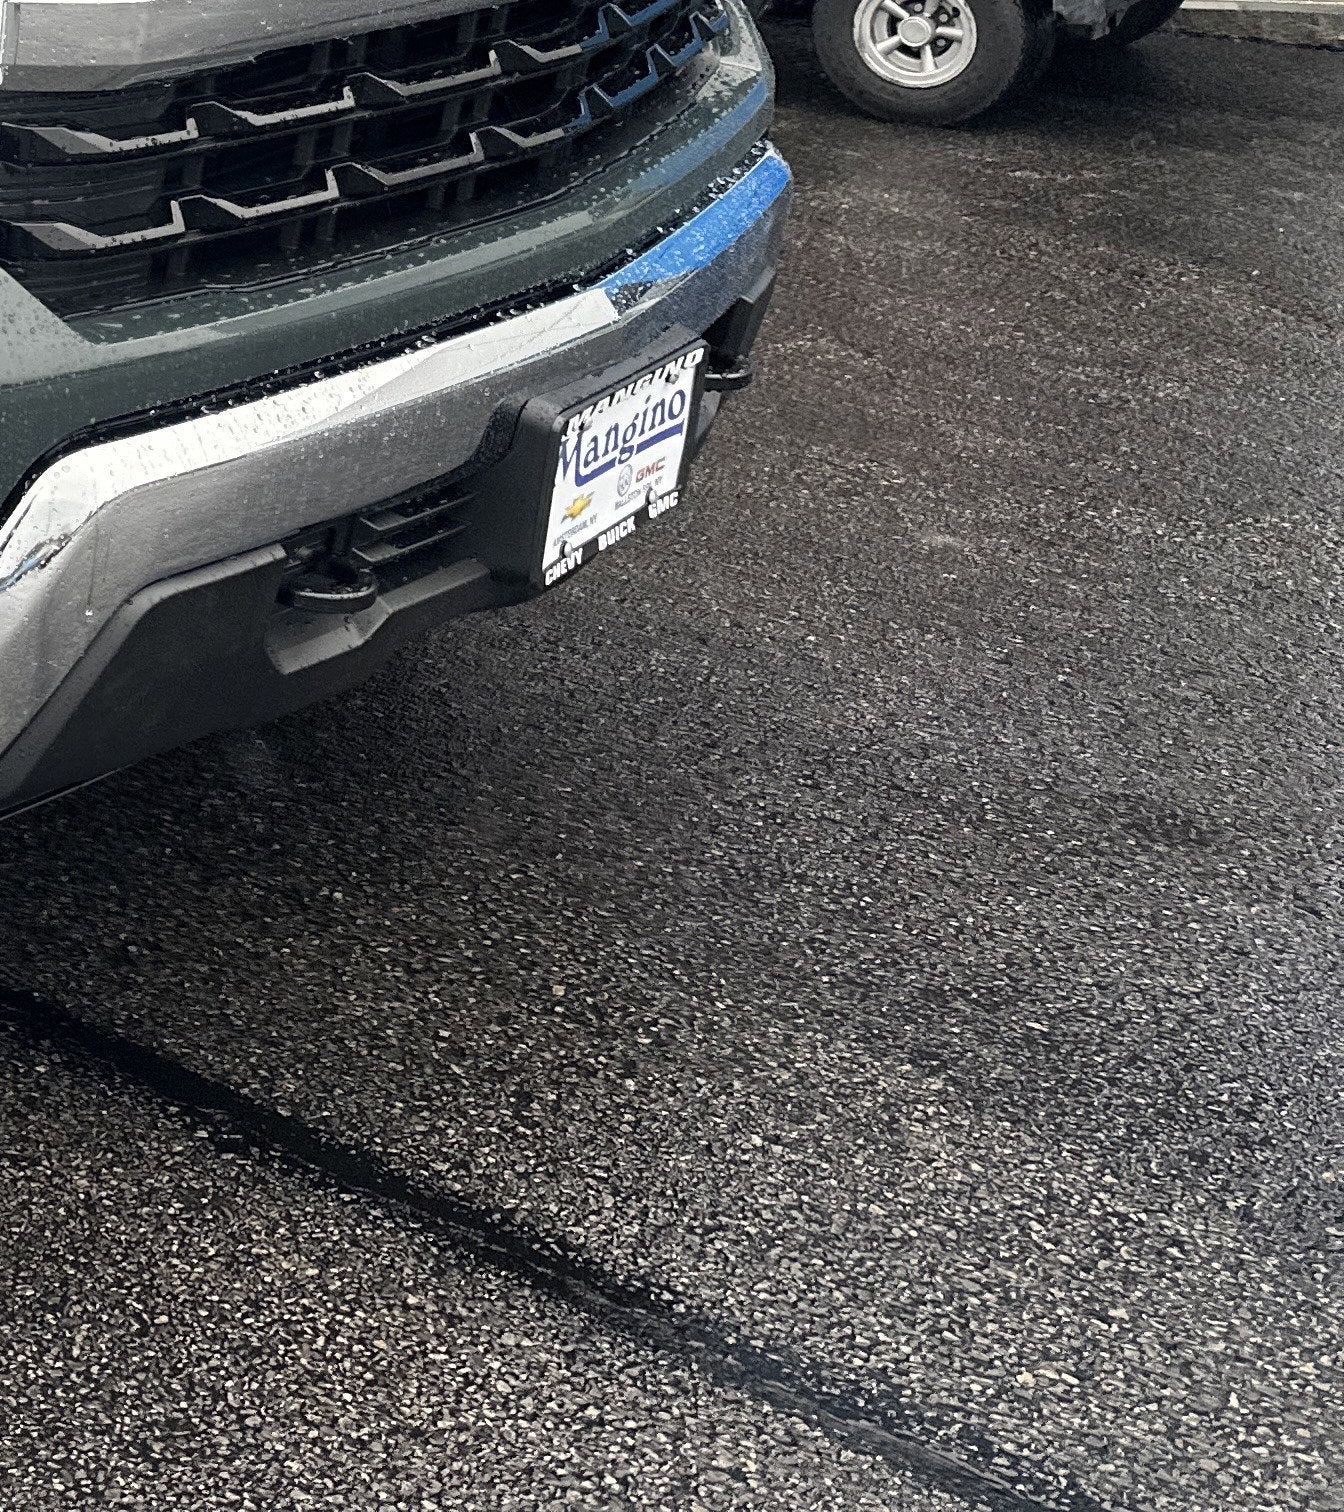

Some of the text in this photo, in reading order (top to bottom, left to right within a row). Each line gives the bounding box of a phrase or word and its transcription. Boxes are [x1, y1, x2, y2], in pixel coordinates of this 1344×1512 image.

[560, 388, 687, 486] Mangino
[566, 347, 705, 437] MANGINO
[635, 455, 666, 484] GMC
[544, 491, 679, 586] CHEVY BUICK GMC
